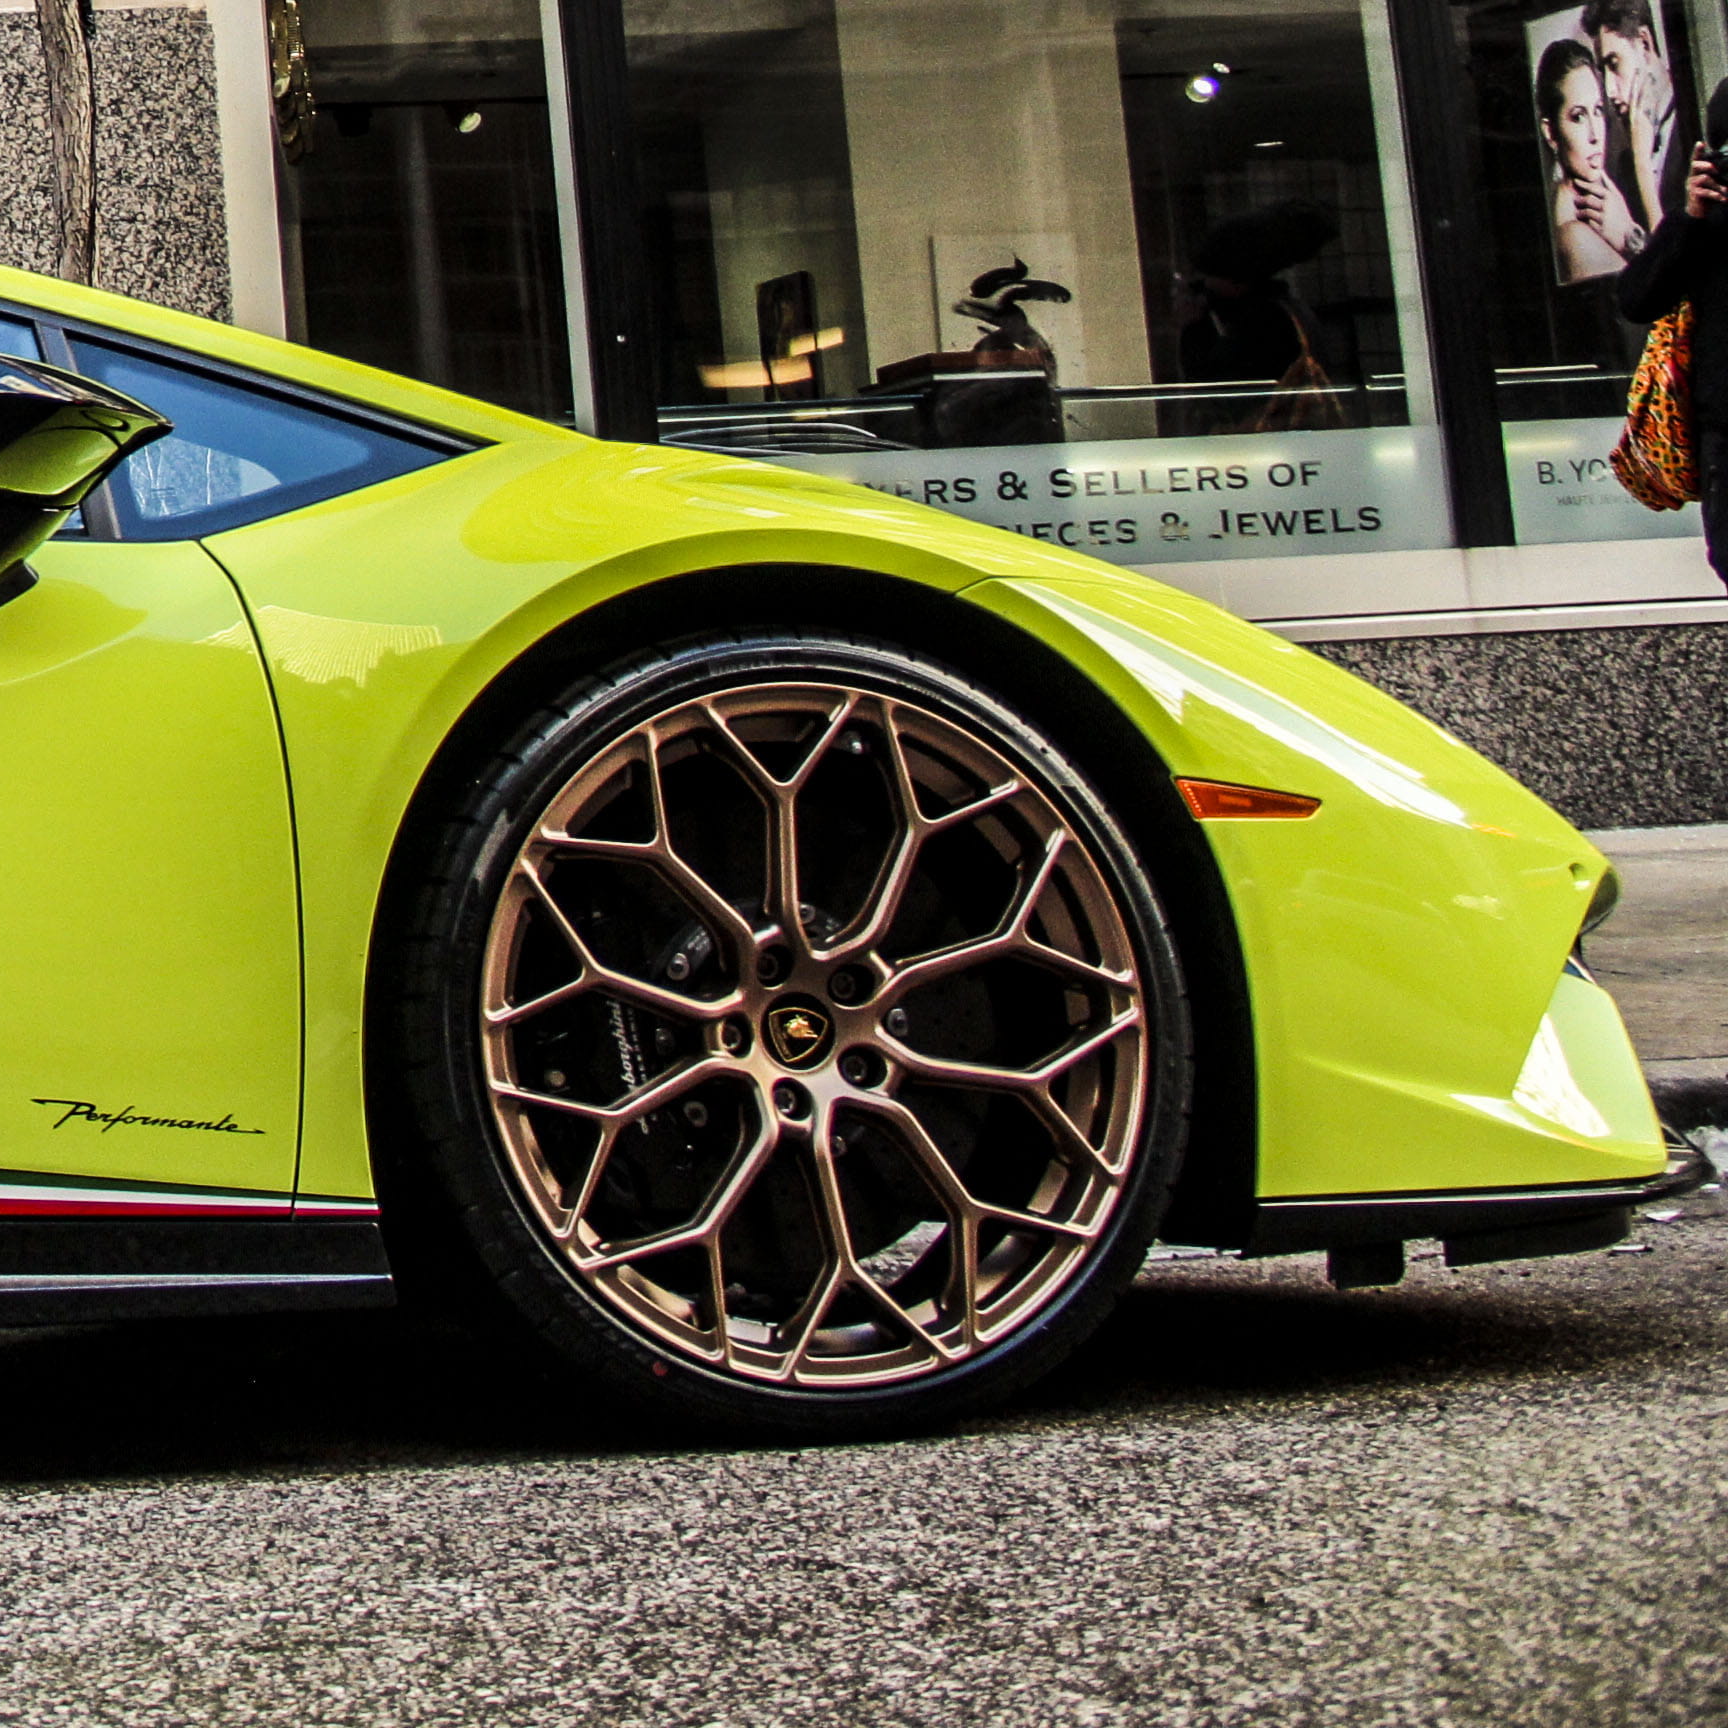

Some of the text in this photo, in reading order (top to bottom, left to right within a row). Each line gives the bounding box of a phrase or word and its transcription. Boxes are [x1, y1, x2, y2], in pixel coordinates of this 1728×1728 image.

[997, 470, 1029, 501] &
[1049, 465, 1249, 499] SELLERS
[1267, 460, 1323, 488] OF
[1536, 460, 1564, 484] B.
[1208, 506, 1383, 540] JEWELS
[30, 1096, 266, 1134] Performante
